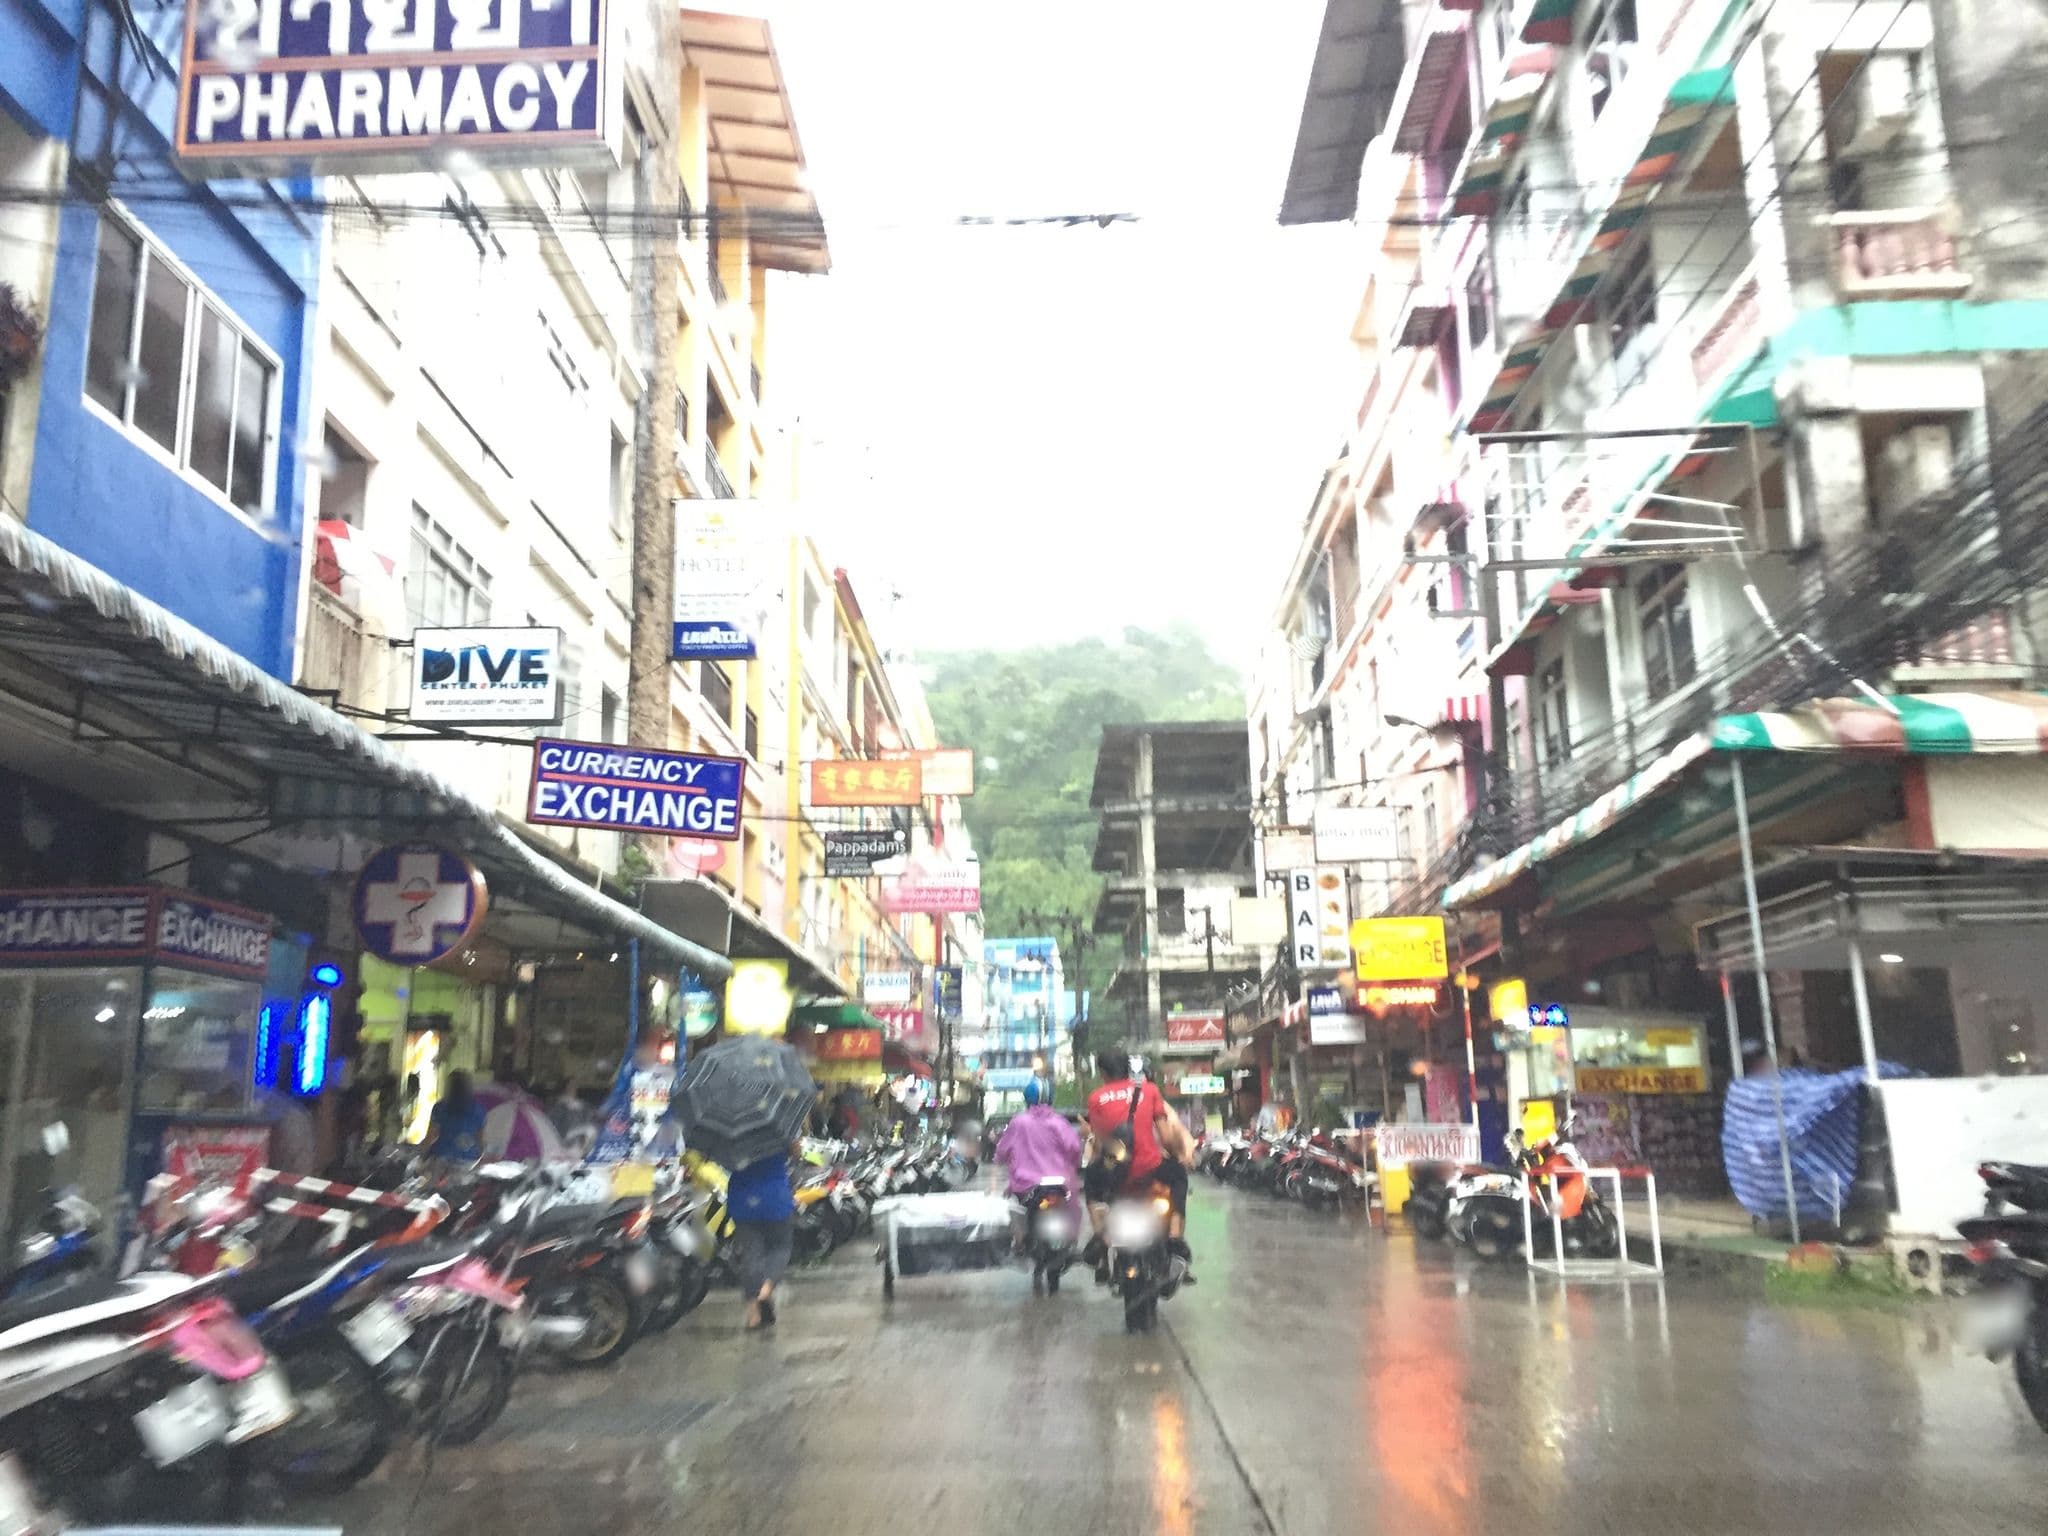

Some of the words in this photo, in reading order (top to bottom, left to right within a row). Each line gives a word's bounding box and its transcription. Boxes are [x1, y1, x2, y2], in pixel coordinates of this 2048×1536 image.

[196, 59, 590, 142] PHARMACY
[421, 646, 550, 683] DIVE
[540, 748, 703, 784] CURRENCY
[534, 781, 737, 832] EXCHANGE
[827, 840, 906, 857] Pappadams
[161, 909, 268, 965] EXCHANGE
[1295, 874, 1316, 962] BAR
[1580, 1070, 1697, 1091] EXCHANGE
